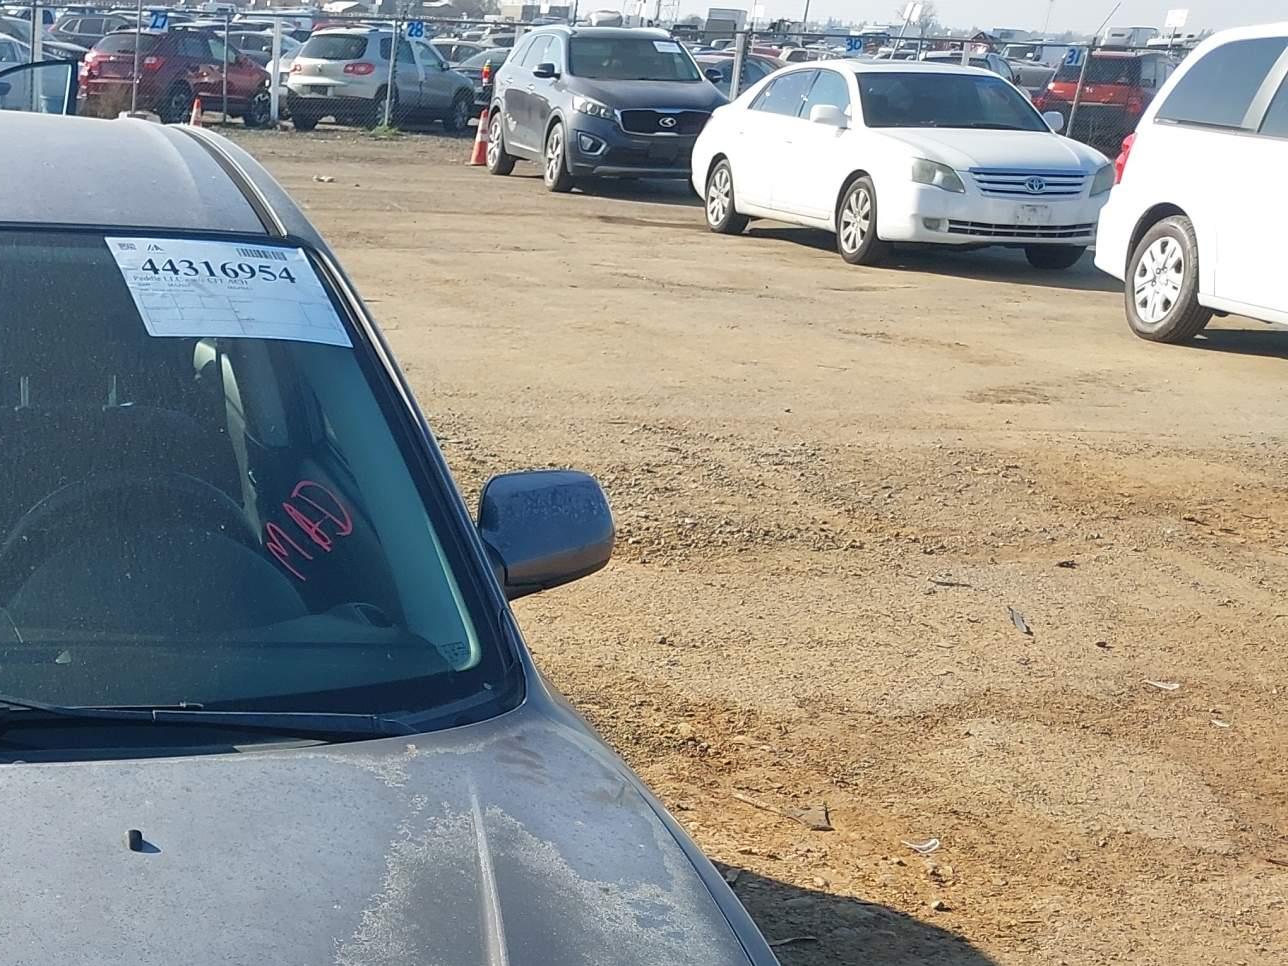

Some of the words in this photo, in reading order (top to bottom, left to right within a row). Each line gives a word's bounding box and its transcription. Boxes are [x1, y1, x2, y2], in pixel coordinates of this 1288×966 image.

[150, 11, 168, 29] 27
[407, 21, 424, 38] 28
[845, 38, 862, 53] 30
[1067, 49, 1081, 64] 31
[142, 257, 296, 284] 44316954
[265, 480, 353, 581] MAD
